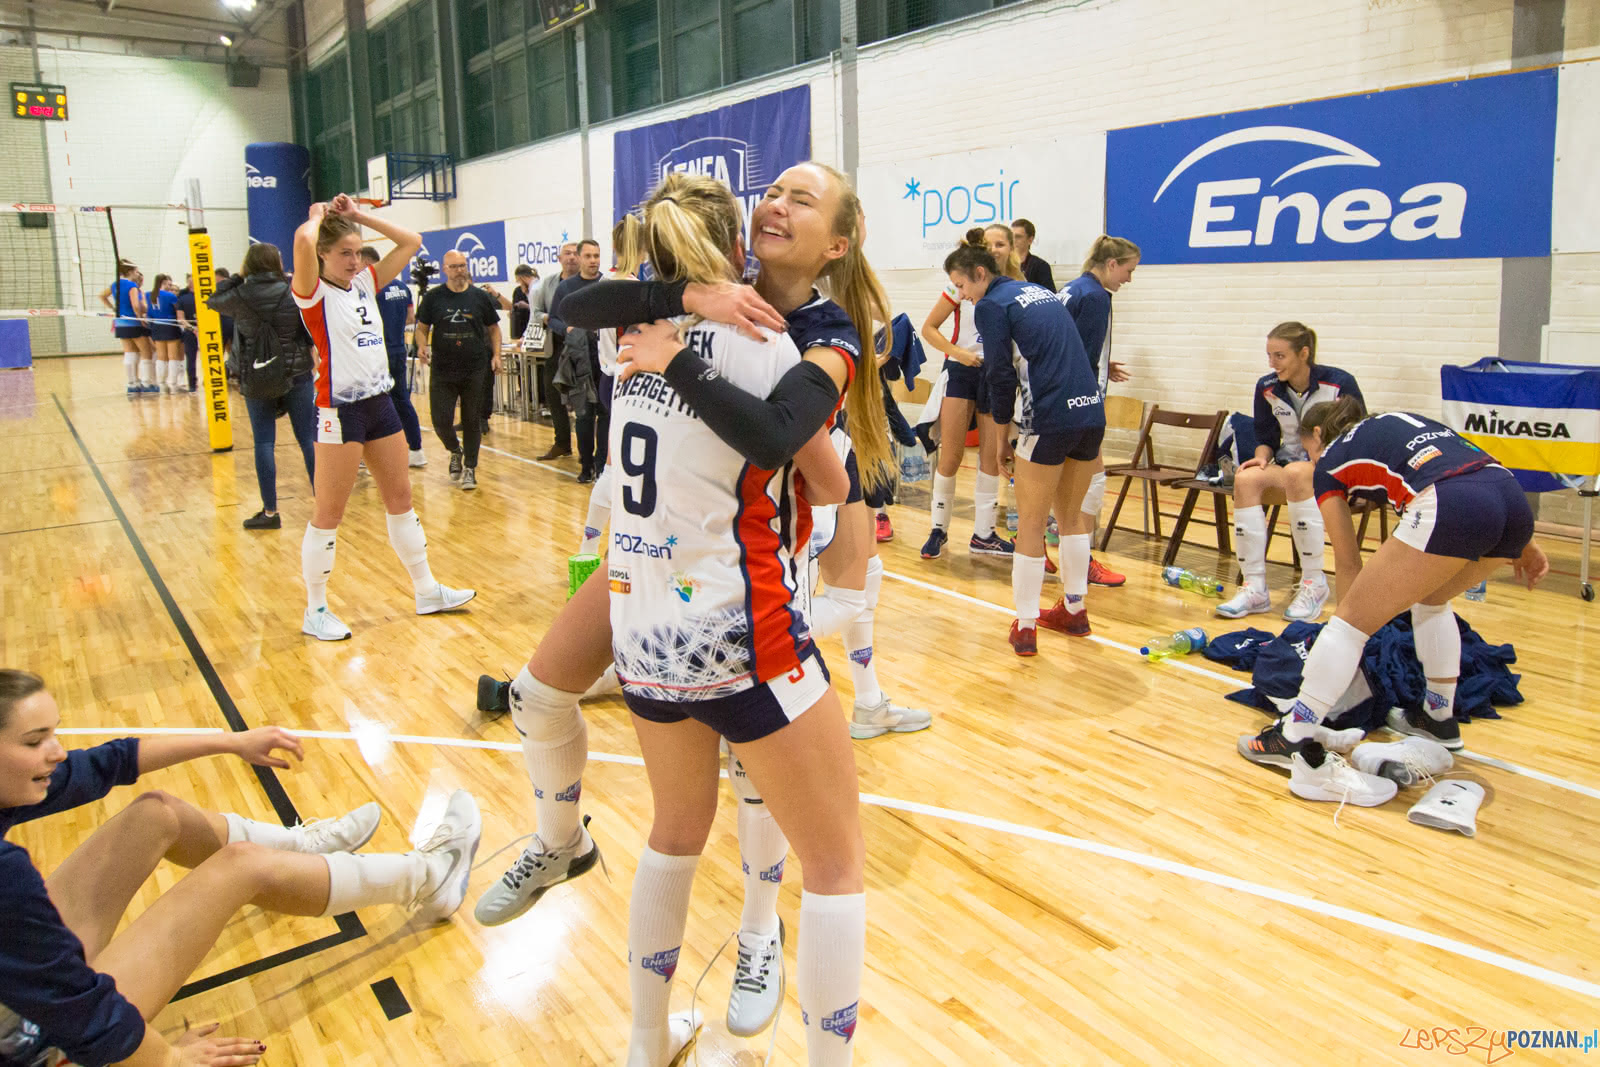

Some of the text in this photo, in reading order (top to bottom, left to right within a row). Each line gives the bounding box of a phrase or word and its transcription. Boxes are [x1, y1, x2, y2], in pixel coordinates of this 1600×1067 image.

[922, 169, 1020, 238] posir
[1189, 178, 1467, 247] Enea
[460, 251, 499, 278] nea
[518, 242, 562, 265] POZna
[355, 306, 373, 326] 2
[357, 336, 383, 348] Enea
[205, 331, 227, 422] TRANSFER
[324, 420, 333, 433] 2
[620, 421, 659, 519] 9
